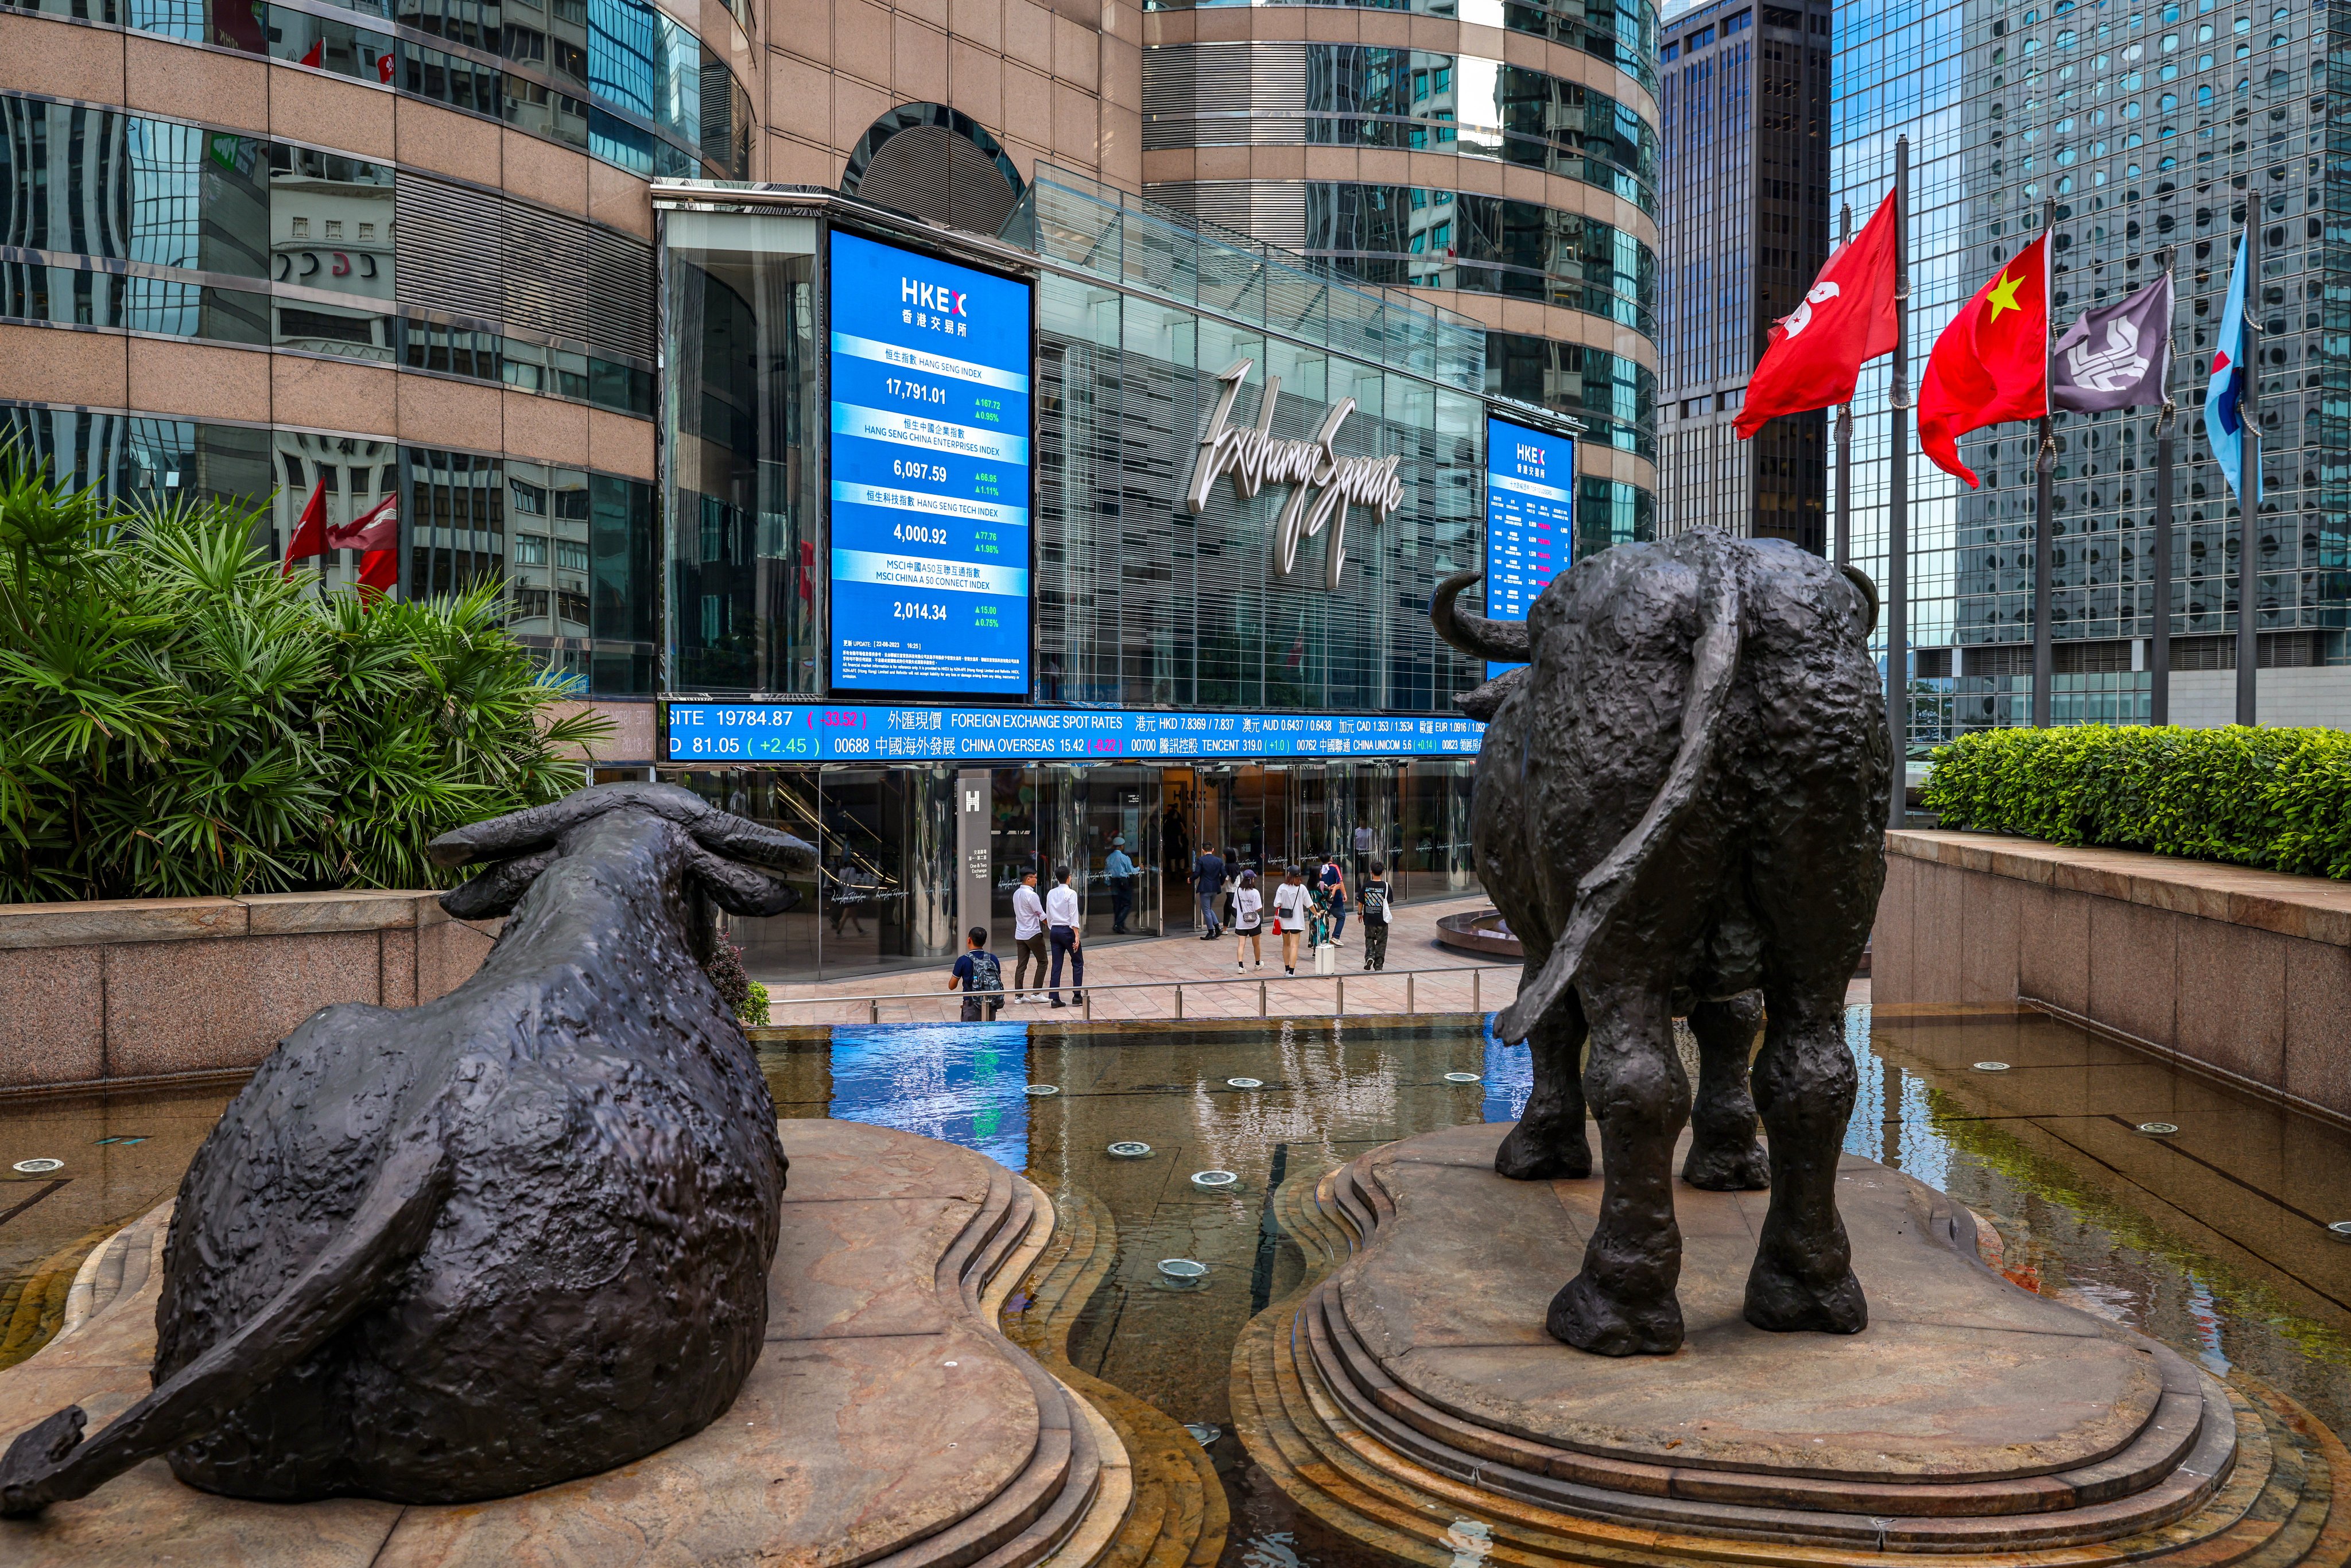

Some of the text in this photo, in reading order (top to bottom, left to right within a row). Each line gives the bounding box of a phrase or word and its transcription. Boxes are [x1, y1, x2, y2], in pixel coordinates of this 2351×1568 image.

[902, 277, 967, 318] HKEX
[902, 309, 967, 337] 香港交易所
[885, 348, 981, 379] 恒生指數 HANG SENG INDEX
[887, 378, 945, 404] 17,791.01
[981, 399, 1000, 409] 167.72
[980, 412, 999, 422] 0.95%
[903, 418, 965, 440] 恒生中國企業指數
[865, 425, 999, 456] HANG SENG CHINA ENTERPRISES INDEX
[1518, 443, 1545, 466] HKEX
[894, 460, 946, 482] 6,097.59
[980, 473, 997, 482] 66.95
[980, 486, 999, 496] 1.11%
[866, 489, 998, 517] 恒生科技指數 HANG SENG TECH INDEX
[894, 524, 946, 544] 4,000.92
[980, 531, 996, 541] 77.76
[980, 545, 999, 554] 1.98%
[876, 572, 893, 580] MSCI
[895, 574, 918, 583] CHINA
[935, 578, 968, 589] CONNECT
[970, 581, 990, 589] INDEX
[894, 601, 946, 620] 2,014.34
[981, 606, 996, 614] 15.00
[980, 619, 999, 627] 0.75%
[717, 711, 793, 725] 19784.87
[888, 711, 941, 730] 外匯現價
[952, 714, 1000, 727] FOREIGN
[1004, 715, 1060, 728] EXCHANGE
[1063, 716, 1089, 728] SPOT
[1092, 716, 1123, 729] RATES
[1135, 716, 1156, 731] 港元
[1159, 718, 1178, 729] HKD
[1181, 718, 1206, 729] 7.8369
[1215, 719, 1234, 730] 7.837
[1243, 717, 1260, 732] 澳元
[1263, 720, 1279, 730] AUD
[1281, 720, 1303, 731] 0.6437
[1310, 720, 1332, 731] 0.6438
[1339, 719, 1354, 733] 加元
[1357, 721, 1371, 731] CAD
[1374, 721, 1388, 731] 1.353
[1395, 721, 1413, 731] 1.3534
[1420, 721, 1433, 733] 歐羅
[1436, 723, 1448, 732] EUR
[1450, 723, 1467, 732] 1.0916
[669, 738, 681, 753] D
[693, 738, 739, 752] 81.05
[835, 738, 869, 752] 00688
[876, 736, 955, 755] 中國海外發展
[962, 739, 995, 752] CHINA
[998, 739, 1054, 752] OVERSEAS
[1060, 739, 1084, 751] 15.42
[1131, 739, 1156, 751] 00700
[1159, 738, 1198, 754] 騰訊控股
[1202, 740, 1239, 751] TENCENT
[1243, 740, 1262, 751] 319.0
[1297, 740, 1317, 750] 00762
[1320, 738, 1350, 752] 中國聯通
[1353, 740, 1374, 750] CHINA
[1375, 740, 1400, 750] UNICOM
[1403, 740, 1411, 750] 5.6
[1442, 740, 1458, 750] 00823
[1460, 738, 1483, 752] 領展房
